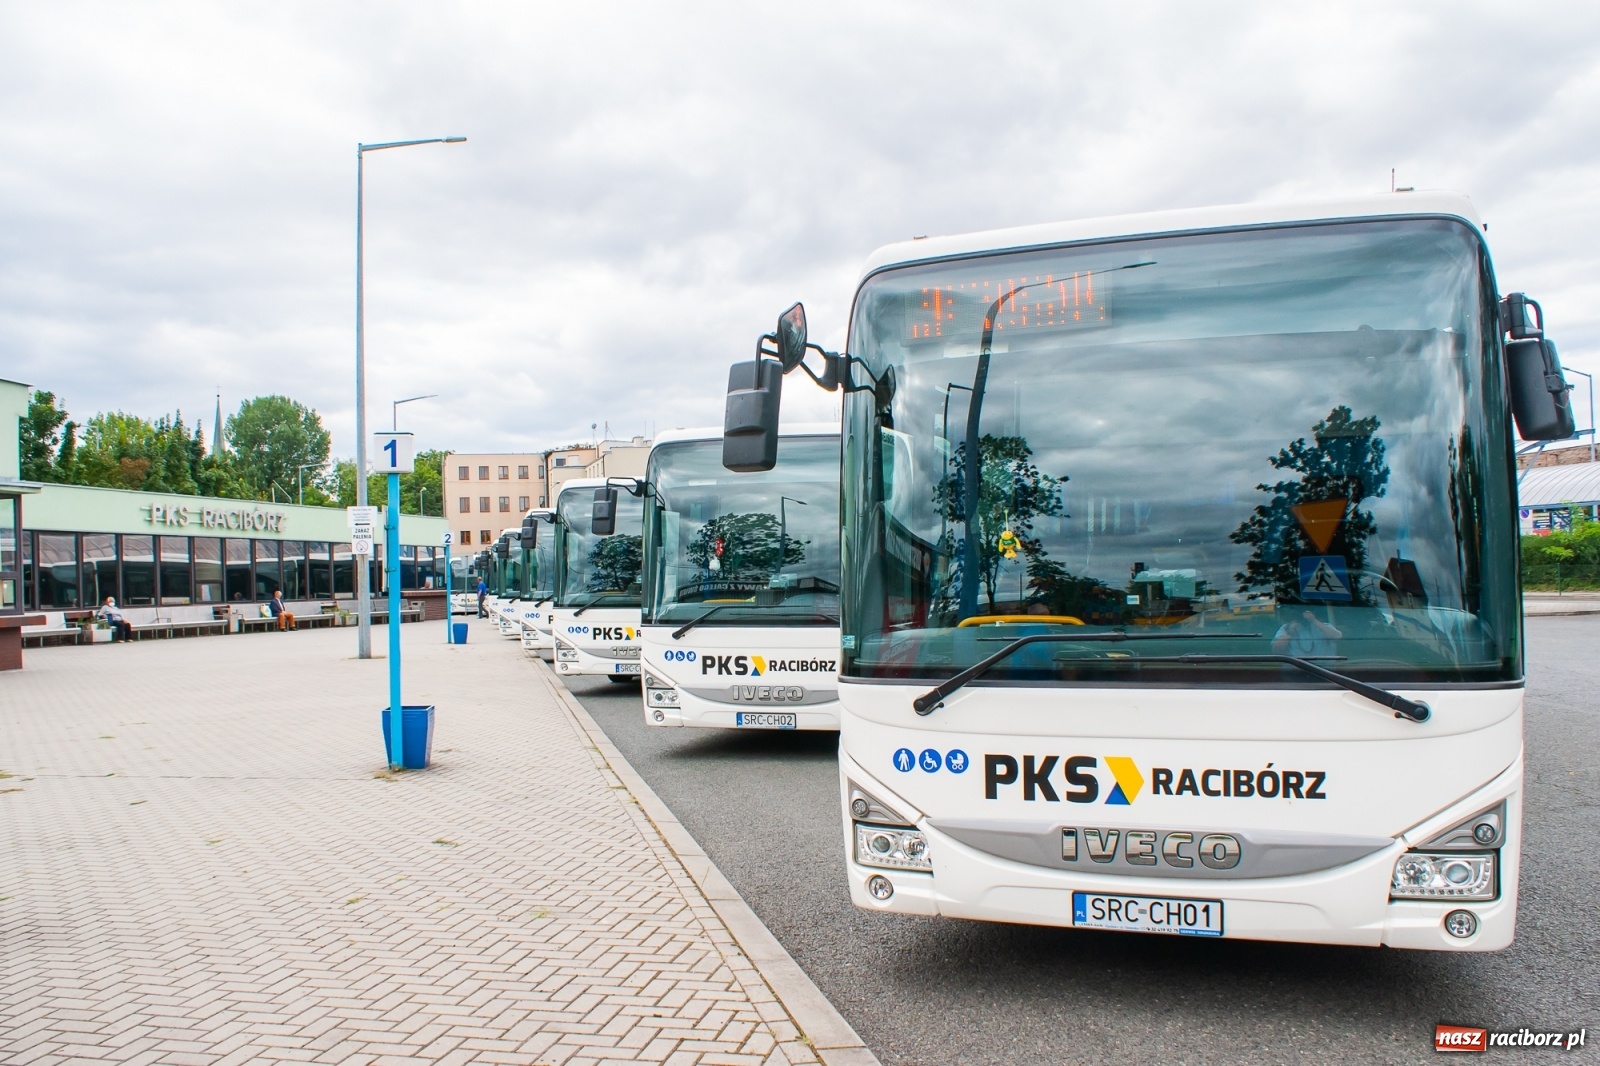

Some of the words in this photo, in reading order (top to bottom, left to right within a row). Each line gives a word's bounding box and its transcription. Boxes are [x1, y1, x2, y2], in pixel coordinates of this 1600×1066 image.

[384, 439, 398, 468] 1
[151, 502, 190, 527] PKS
[202, 505, 285, 532] RACIBÓRZ
[444, 533, 452, 543] 2
[593, 627, 623, 640] PKS
[702, 655, 749, 676] PKS
[769, 657, 837, 672] RACIBÓRZ
[732, 685, 804, 702] IVECO
[984, 753, 1100, 803] PKS
[1152, 763, 1327, 799] RACIBÓRZ
[1061, 827, 1242, 870] IVECO
[1076, 910, 1085, 918] PL
